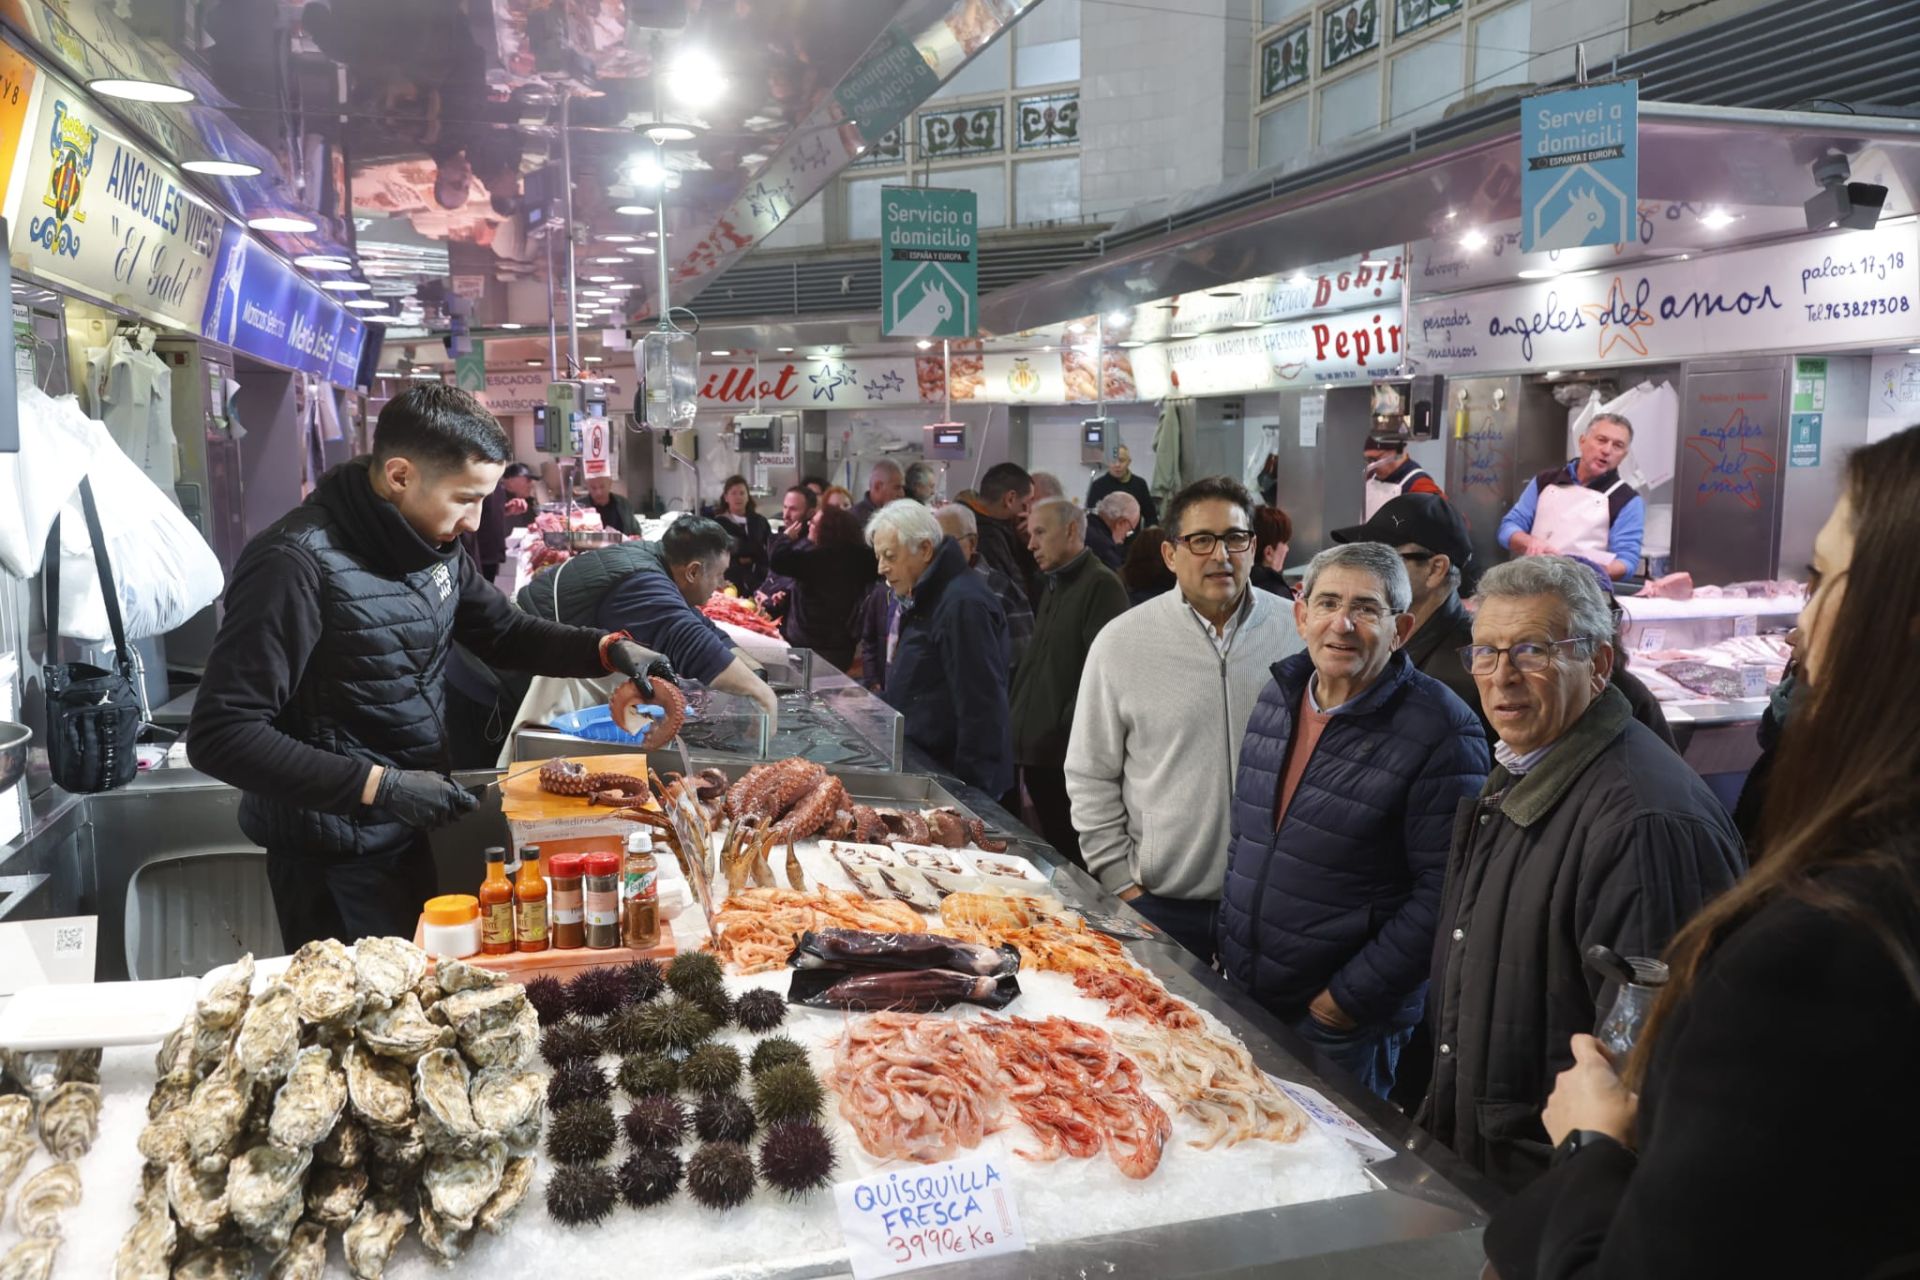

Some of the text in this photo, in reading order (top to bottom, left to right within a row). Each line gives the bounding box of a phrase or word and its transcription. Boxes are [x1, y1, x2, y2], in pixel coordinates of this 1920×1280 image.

[11, 85, 20, 105] 8
[1538, 101, 1622, 131] Servei a
[1537, 123, 1622, 155] domicili
[1549, 154, 1582, 167] ESPANYA
[1588, 148, 1618, 161] EUROPA
[106, 145, 219, 259] ANGUILES VIVES
[887, 201, 973, 225] Servicio a
[889, 225, 972, 248] domicilio
[909, 250, 962, 261] ESPAÑA Y EUROPA
[1801, 251, 1904, 295] palcos 17 y 18
[1423, 306, 1472, 343] pescados
[1489, 277, 1783, 362] angeles del amor
[1263, 328, 1310, 352] FRESCOS
[1427, 345, 1478, 360] mariscos
[486, 373, 543, 386] ESCADOS
[508, 387, 517, 397] Y
[1699, 415, 1763, 452] angeles
[1712, 452, 1749, 474] del
[1698, 480, 1755, 495] amor
[881, 1195, 983, 1236] FRESCA
